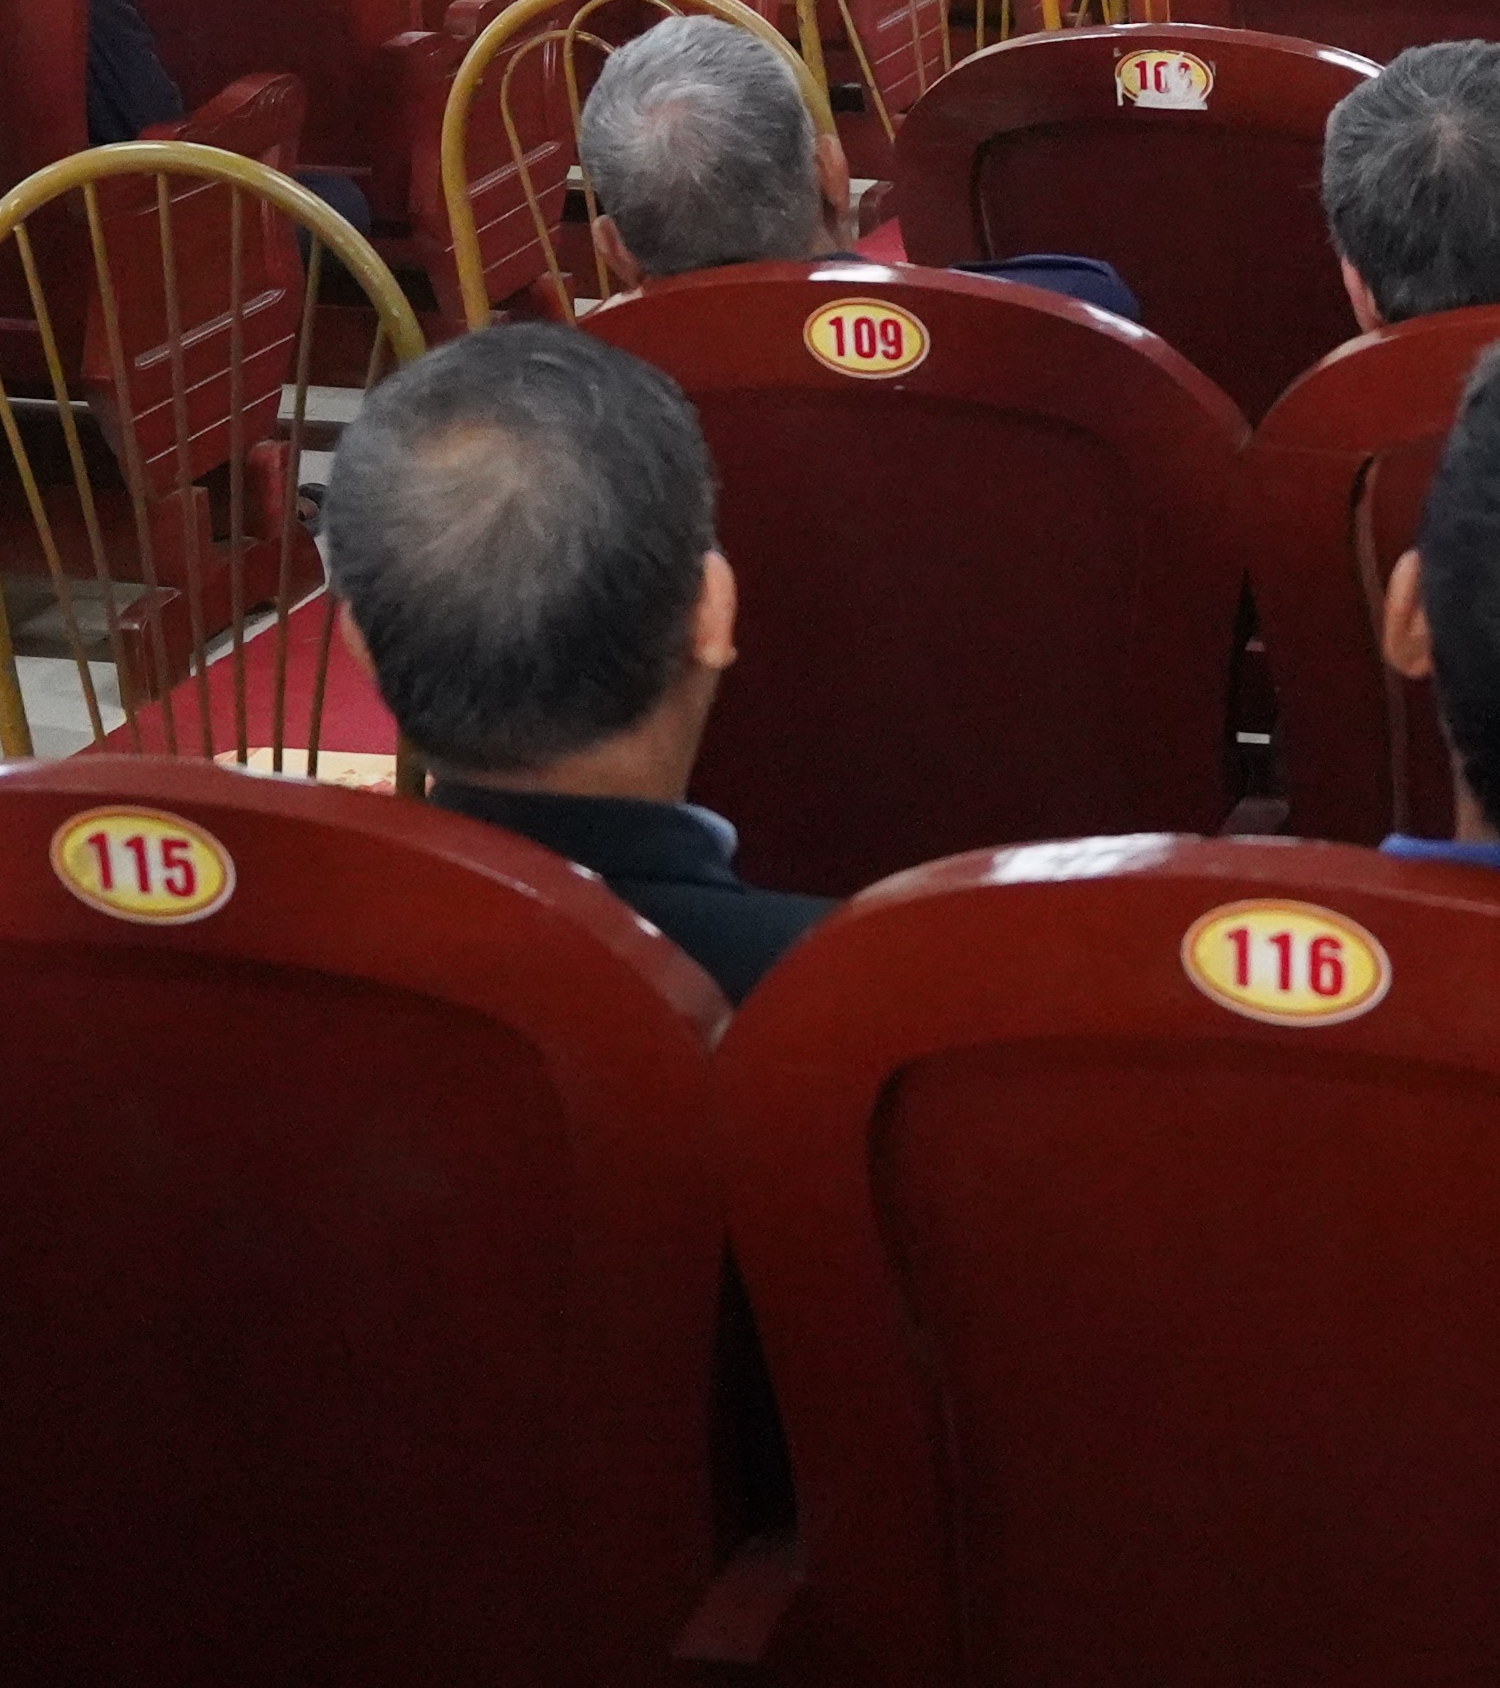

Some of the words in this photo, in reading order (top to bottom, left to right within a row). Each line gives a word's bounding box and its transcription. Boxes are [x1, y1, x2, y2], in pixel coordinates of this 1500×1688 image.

[827, 316, 903, 359] 109
[85, 830, 195, 900] 115
[1225, 927, 1345, 997] 116
